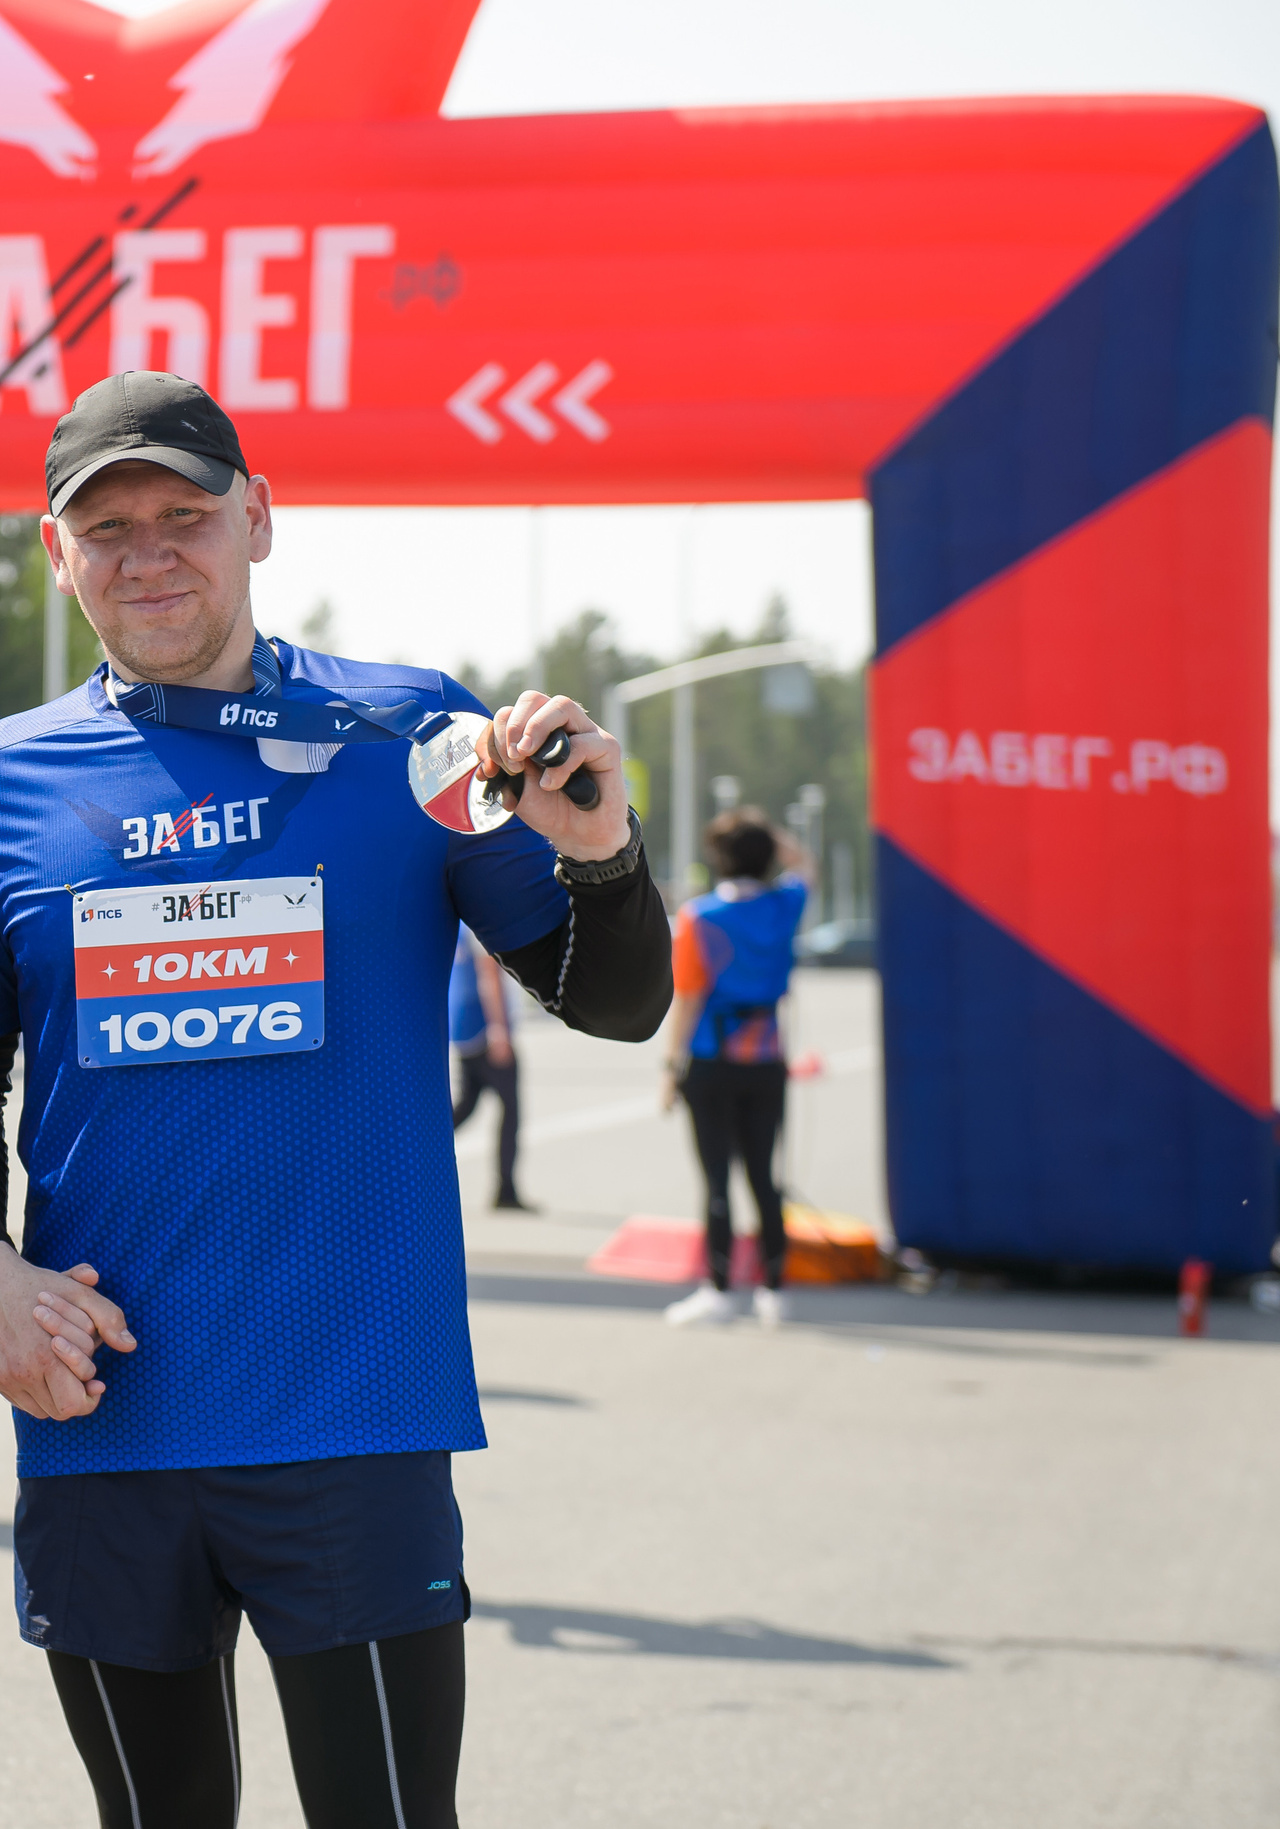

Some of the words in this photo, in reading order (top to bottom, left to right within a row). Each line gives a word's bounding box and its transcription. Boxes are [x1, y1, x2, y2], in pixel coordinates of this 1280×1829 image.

[241, 708, 279, 728] ПСБ
[907, 727, 1228, 798] ЗАБЕГ.РФ
[97, 909, 122, 920] ПСБ
[99, 1001, 303, 1054] 10076
[427, 1580, 451, 1590] JOSS
